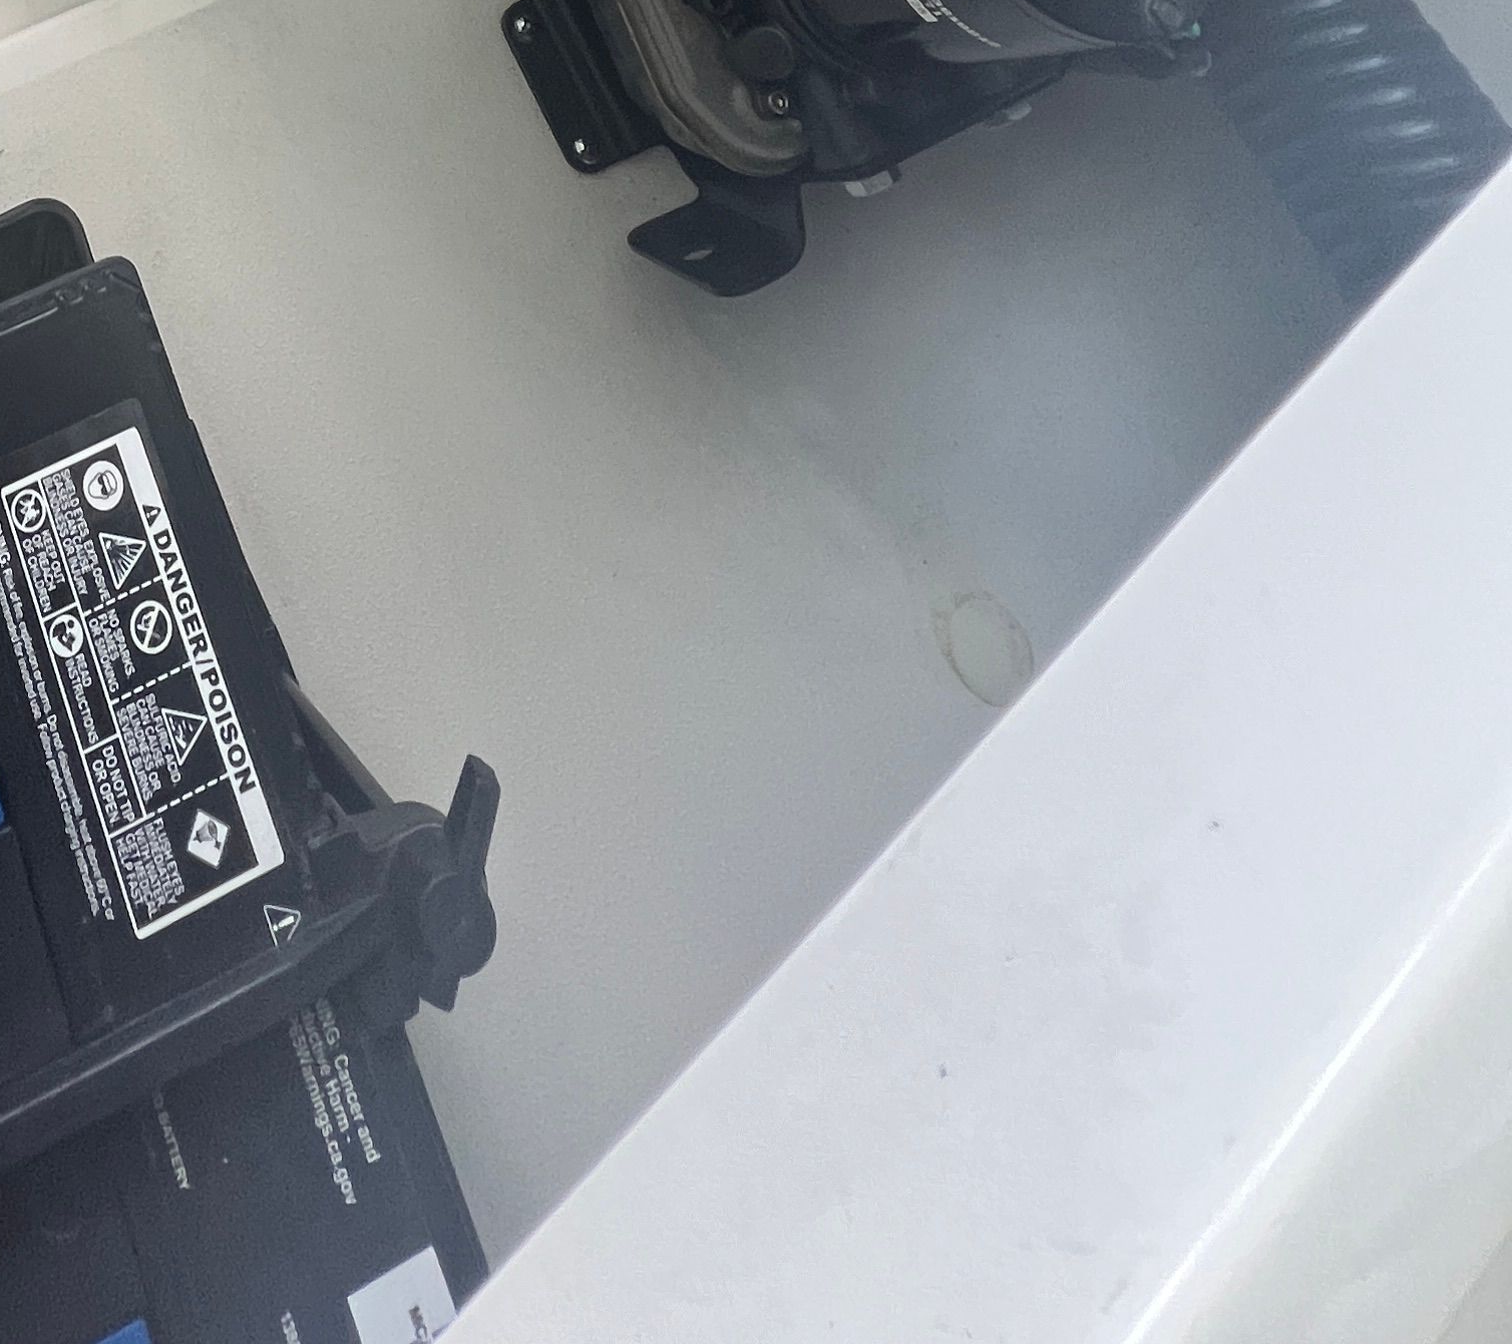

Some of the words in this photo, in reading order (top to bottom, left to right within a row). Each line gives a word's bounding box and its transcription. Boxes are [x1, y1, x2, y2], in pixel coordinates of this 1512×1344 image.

[32, 534, 43, 549] OF
[43, 477, 68, 537] BLINDNESS
[62, 538, 74, 556] OR
[52, 473, 70, 510] GASES
[64, 511, 78, 535] CAN
[72, 536, 91, 574] CAUSE
[61, 468, 79, 507] SHIELD
[83, 539, 112, 602] EXPLOSIVE
[22, 538, 34, 553] OF
[28, 556, 51, 612] CHILDREN
[37, 551, 56, 591] REACH
[41, 529, 57, 559] KEEP
[51, 560, 65, 583] OUT
[89, 618, 101, 637] OR
[98, 613, 119, 661] FLAMES
[107, 608, 119, 627] NO
[75, 653, 92, 687] READ
[94, 637, 119, 692] SMOKING
[154, 530, 255, 792] DANGER/POISON
[33, 670, 42, 680] or
[47, 714, 57, 732] Do
[52, 732, 64, 751] not
[65, 658, 98, 744] INSTRUCTIONS
[117, 708, 138, 756] SEVERE
[136, 698, 151, 725] CAN
[145, 726, 164, 768] CAUSE
[145, 693, 171, 752] SULFURIC
[13, 641, 23, 656] for
[37, 723, 52, 758] Follow
[46, 759, 67, 801] product
[61, 801, 80, 850] charging
[92, 759, 107, 782] OR
[126, 703, 154, 771] BLINDNESS
[148, 772, 161, 791] OR
[102, 745, 117, 768] DO
[110, 768, 127, 798] NOT
[120, 799, 135, 822] TIP
[116, 838, 133, 870] HELP
[135, 827, 151, 860] WITH
[144, 822, 177, 903] IMMEDIATELY
[153, 817, 173, 860] FLUSH
[125, 833, 140, 858] GET
[134, 860, 157, 919] MEDICAL
[325, 1079, 349, 1133] Harm
[335, 1054, 365, 1121] Cancer
[357, 1124, 381, 1164] and
[158, 1110, 190, 1190] BATTERY
